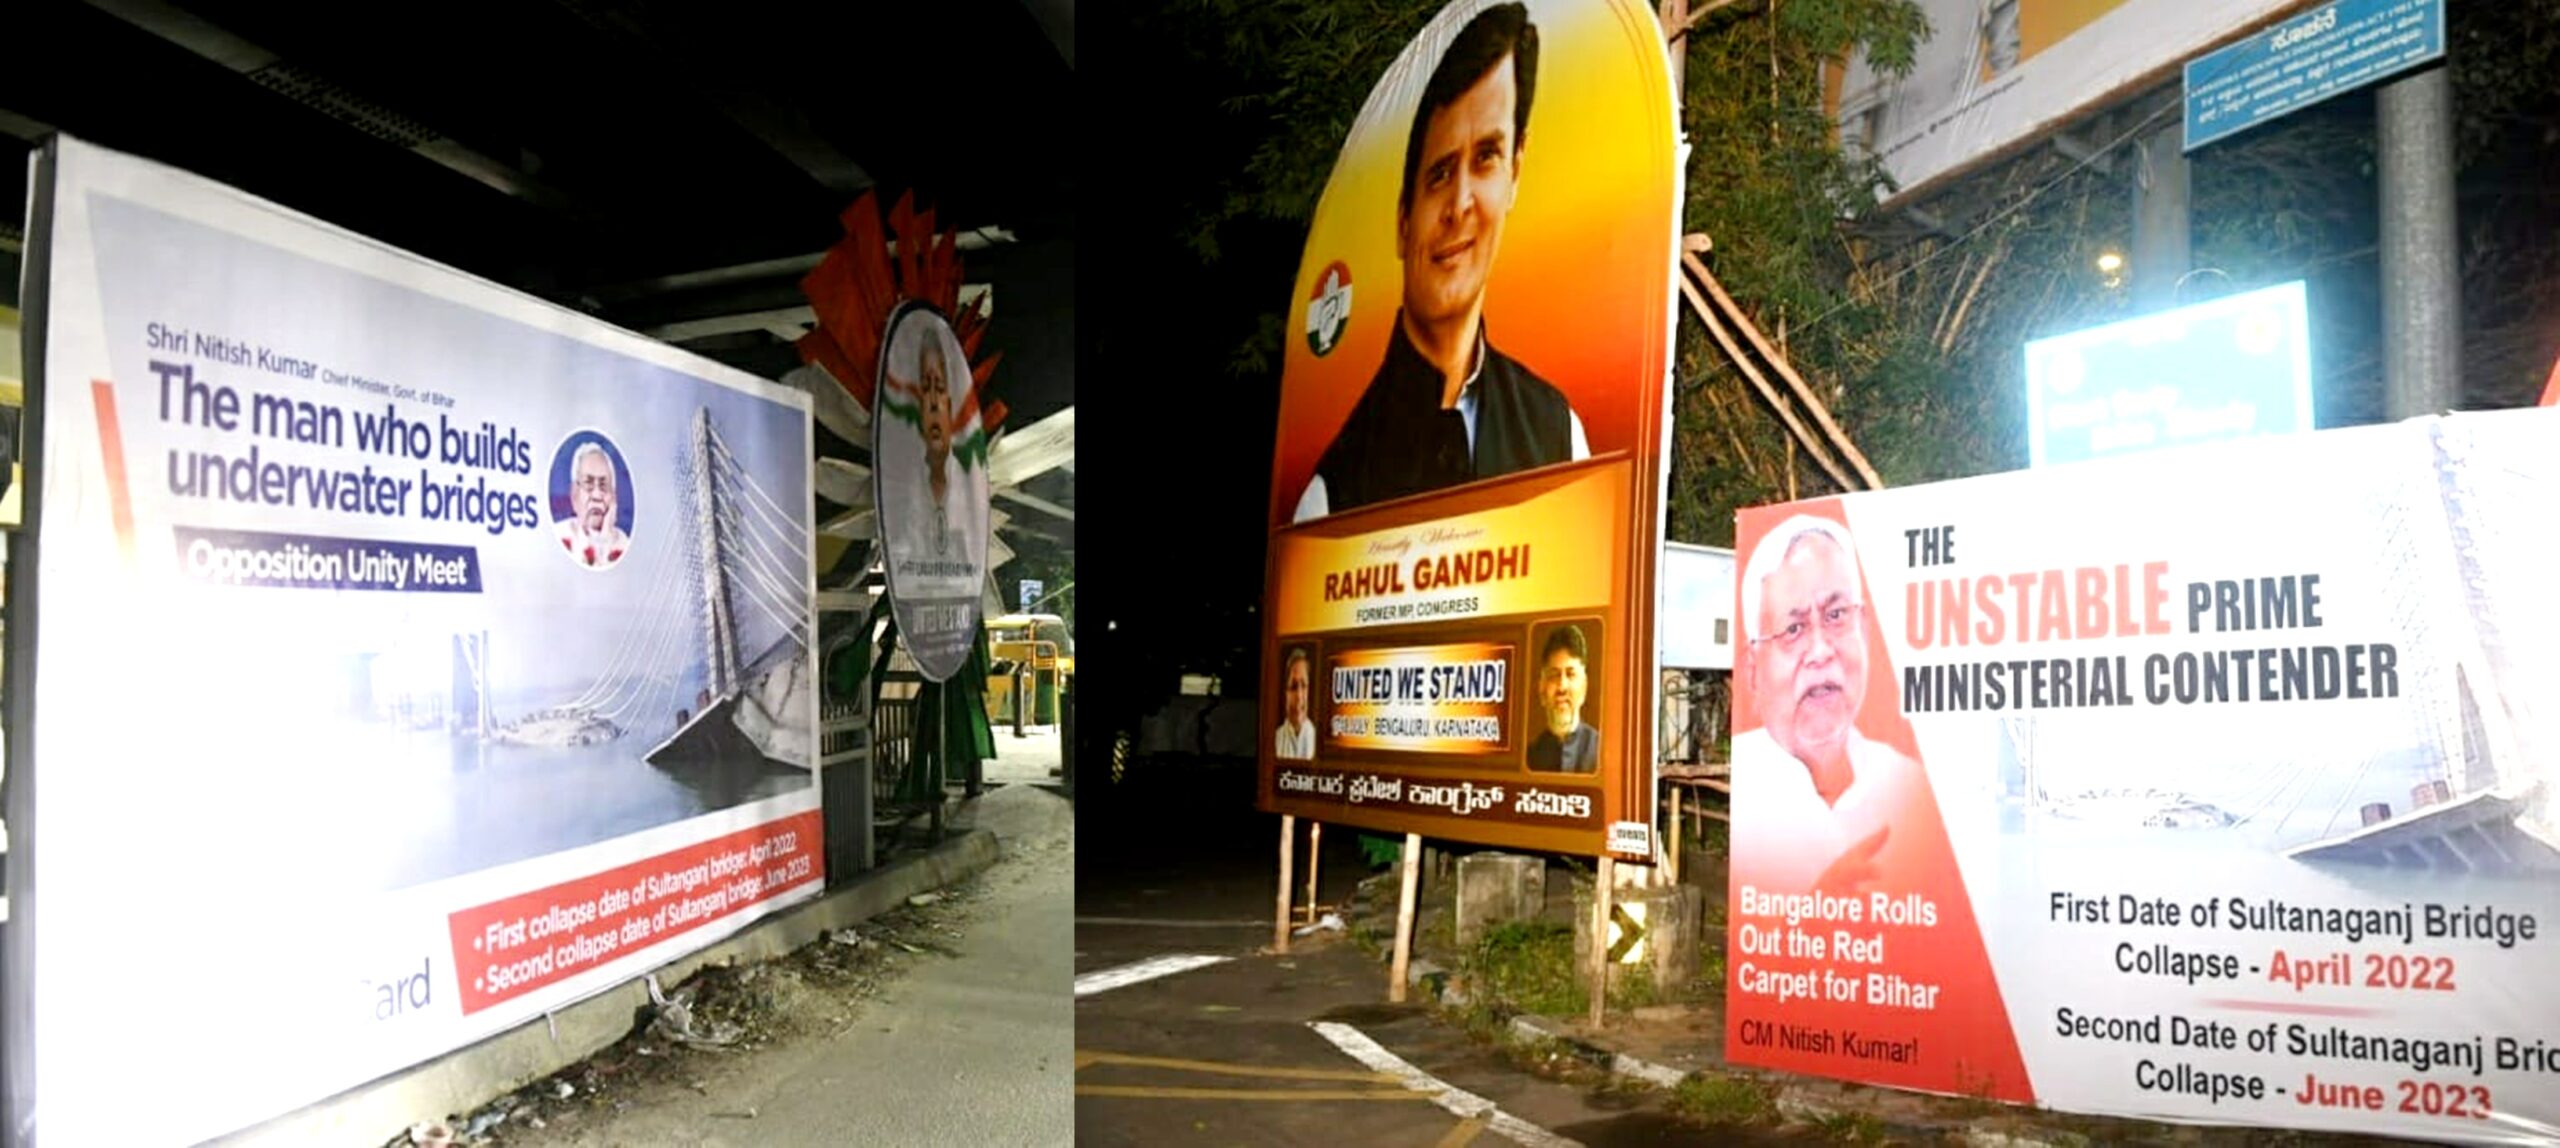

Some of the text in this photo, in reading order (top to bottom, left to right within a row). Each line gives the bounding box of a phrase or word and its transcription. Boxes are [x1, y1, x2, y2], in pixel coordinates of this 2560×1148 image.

[147, 323, 188, 353] Shri
[194, 333, 251, 369] Nitish
[257, 348, 319, 381] Kumar
[421, 392, 430, 403] of
[149, 361, 530, 475] The man who builds
[169, 437, 538, 535] underwater bridges
[187, 538, 467, 588] Opposition Unity Meet
[1324, 544, 1531, 602] RAHUL GANDHI
[1904, 525, 1955, 568] THE
[1357, 605, 1397, 623] FORMER
[1416, 597, 1480, 615] CONGRESS
[1905, 561, 2323, 650] UNSTABLE PRIME
[1333, 661, 1505, 700] UNITED WE STAND!
[1904, 643, 2399, 713] MINISTERIAL CONTENDER
[1434, 718, 1498, 741] KARNATAKA
[1408, 782, 1505, 815] ಕಾಂಗ್ರೆಸ್
[1515, 788, 1592, 818] ಸಮಿತಿ
[486, 919, 526, 952] First
[529, 900, 596, 944] collapse
[599, 887, 628, 918] date
[632, 881, 646, 907] of
[648, 860, 709, 900] Sultanganj
[749, 837, 773, 866] April
[774, 831, 797, 854] 2022
[1740, 886, 1937, 927] Bangalore Rolls
[487, 951, 553, 994] Second
[556, 929, 618, 972] collapse
[620, 917, 650, 944] date
[653, 909, 666, 935] of
[668, 886, 727, 927] Sultanganj
[764, 866, 787, 888] June
[787, 855, 810, 881] 2023
[1739, 925, 1883, 964] Out the Red
[2051, 892, 2537, 948] First Date of Sultanaganj Bridge
[361, 957, 430, 1020] ard
[1738, 962, 1939, 1008] Carpet for Bihar
[2116, 943, 2239, 985] Collapse
[2269, 950, 2351, 990] April
[2364, 954, 2456, 991] 2022
[1740, 1019, 1918, 1065] CM Nitish Kumar!
[2056, 1008, 2160, 1044] Second
[2171, 1016, 2236, 1050] Date
[2248, 1022, 2277, 1054] of
[2287, 1023, 2483, 1076] Sultanaganj
[2135, 1060, 2265, 1102] Collapse
[2296, 1073, 2384, 1111] June
[2397, 1080, 2493, 1120] 2023
